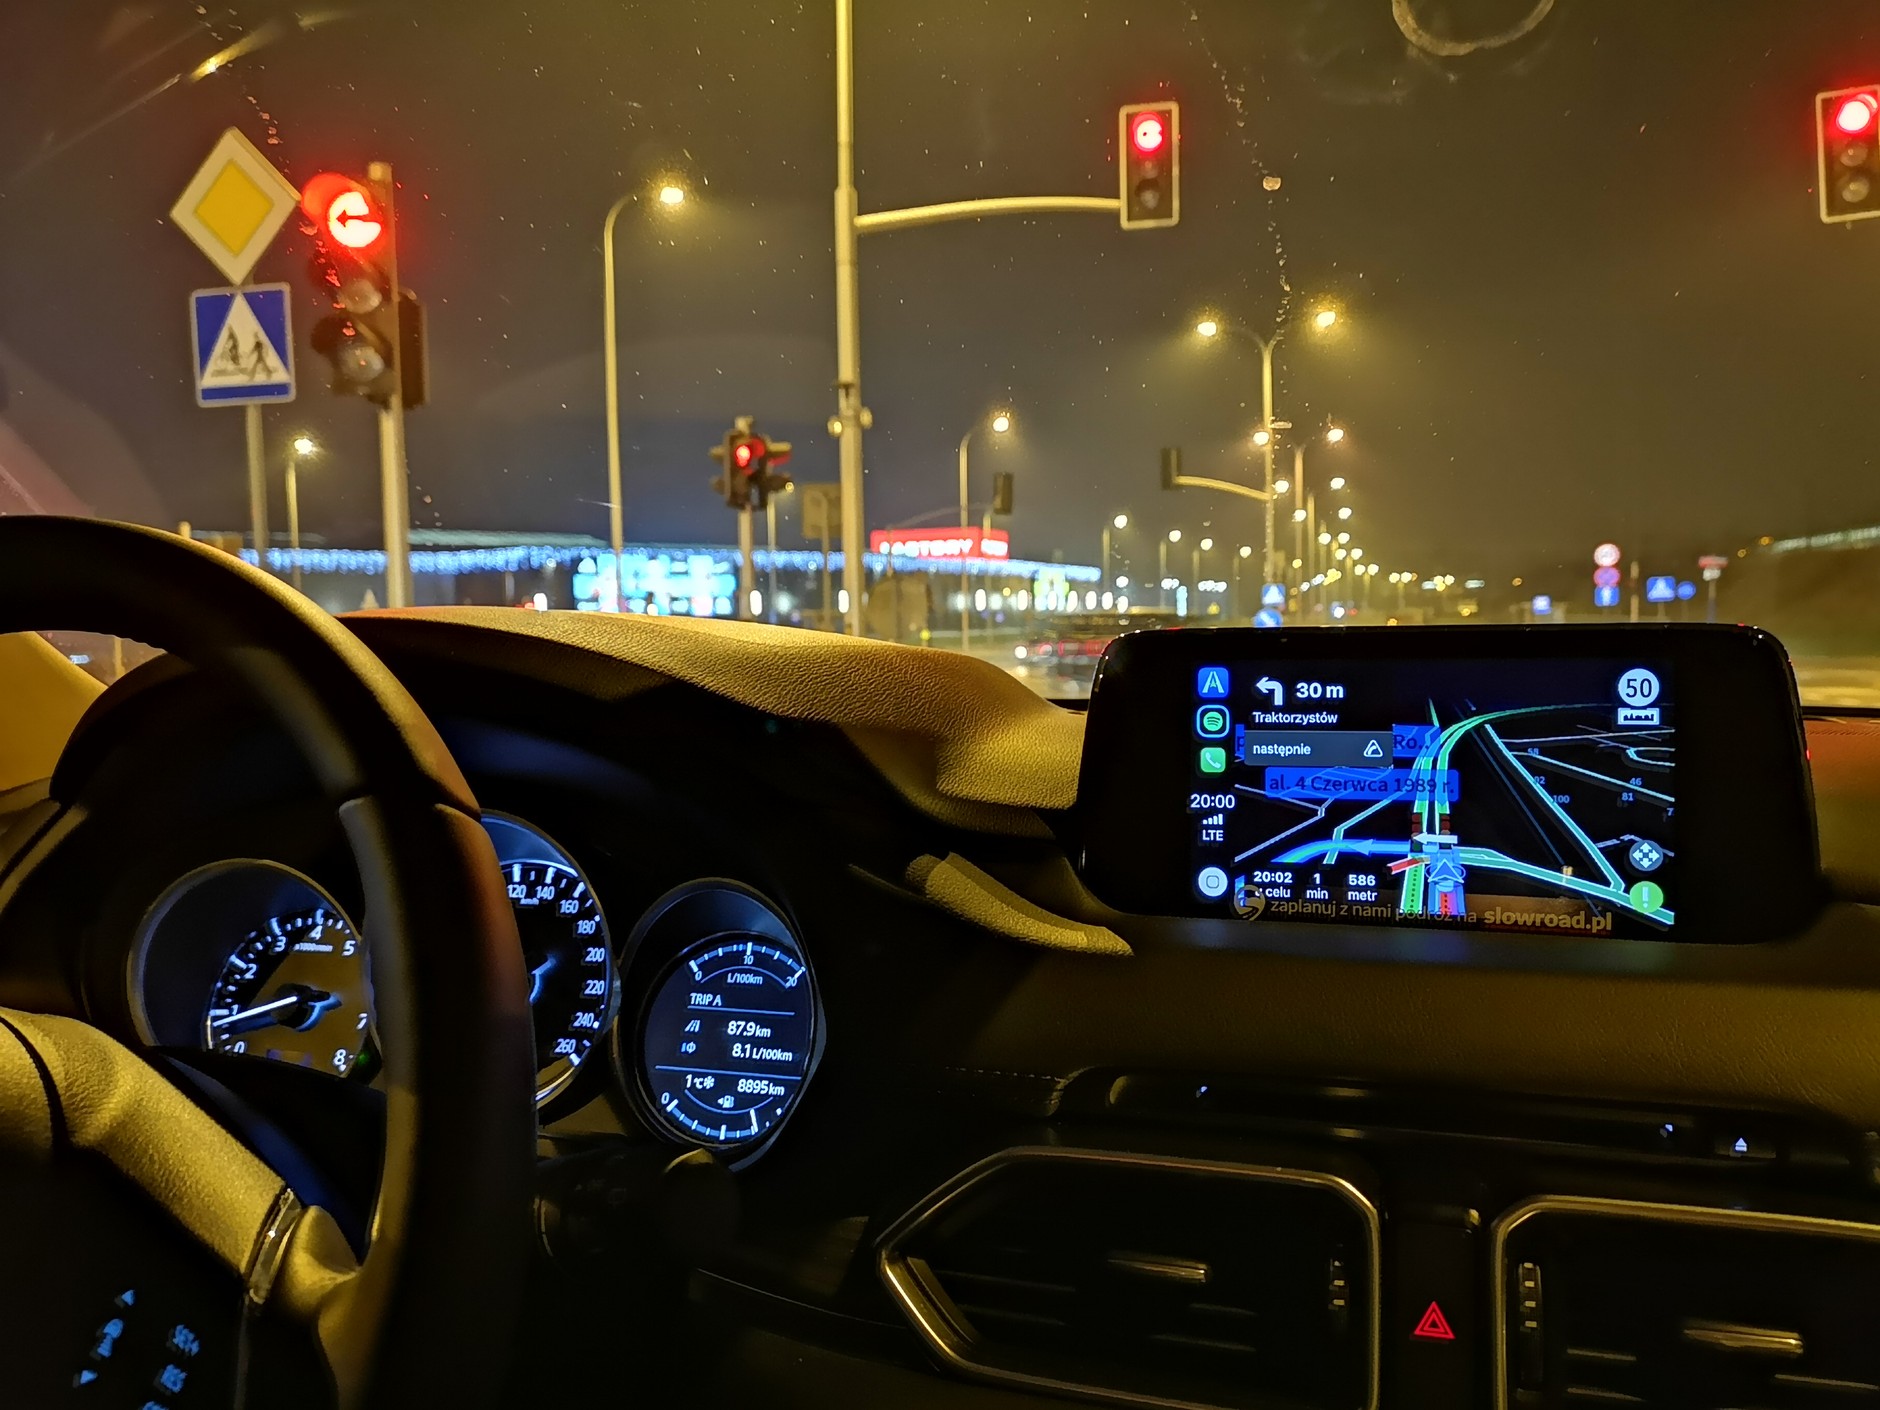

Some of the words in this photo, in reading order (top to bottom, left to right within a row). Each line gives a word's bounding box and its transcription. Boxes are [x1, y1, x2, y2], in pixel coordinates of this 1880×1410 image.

[1296, 682, 1322, 699] 30
[1326, 685, 1344, 699] m
[1625, 678, 1653, 698] 50
[1252, 711, 1338, 725] Traktorzystów
[1252, 742, 1311, 756] następnie
[1269, 774, 1291, 791] al.
[1295, 776, 1306, 790] 4
[1310, 776, 1388, 793] Czerwca
[1394, 778, 1437, 794] 1989
[1629, 777, 1642, 786] 46
[1190, 794, 1236, 809] 20:00
[1621, 792, 1634, 801] 81
[1202, 829, 1224, 842] LTE
[1253, 870, 1293, 884] 20:02
[1313, 873, 1321, 885] 1
[1348, 874, 1376, 887] 586
[507, 884, 527, 899] 120
[535, 885, 555, 900] 140
[1265, 885, 1291, 898] celu
[1306, 888, 1329, 900] min
[1348, 889, 1378, 902] metr
[559, 900, 579, 914] 160
[307, 925, 323, 941] 4
[576, 919, 596, 935] 180
[273, 936, 286, 952] 3
[341, 939, 356, 956] 5
[584, 947, 605, 962] 200
[742, 954, 754, 965] 10
[243, 963, 257, 980] 2
[695, 971, 702, 981] 0
[726, 973, 763, 985] L/100km
[785, 976, 797, 988] 20
[583, 980, 605, 995] 220
[689, 992, 713, 1006] TRIP
[712, 994, 722, 1007] A
[572, 1011, 595, 1028] 240
[554, 1038, 577, 1054] 260
[333, 1048, 347, 1066] 8
[661, 1092, 670, 1105] 0
